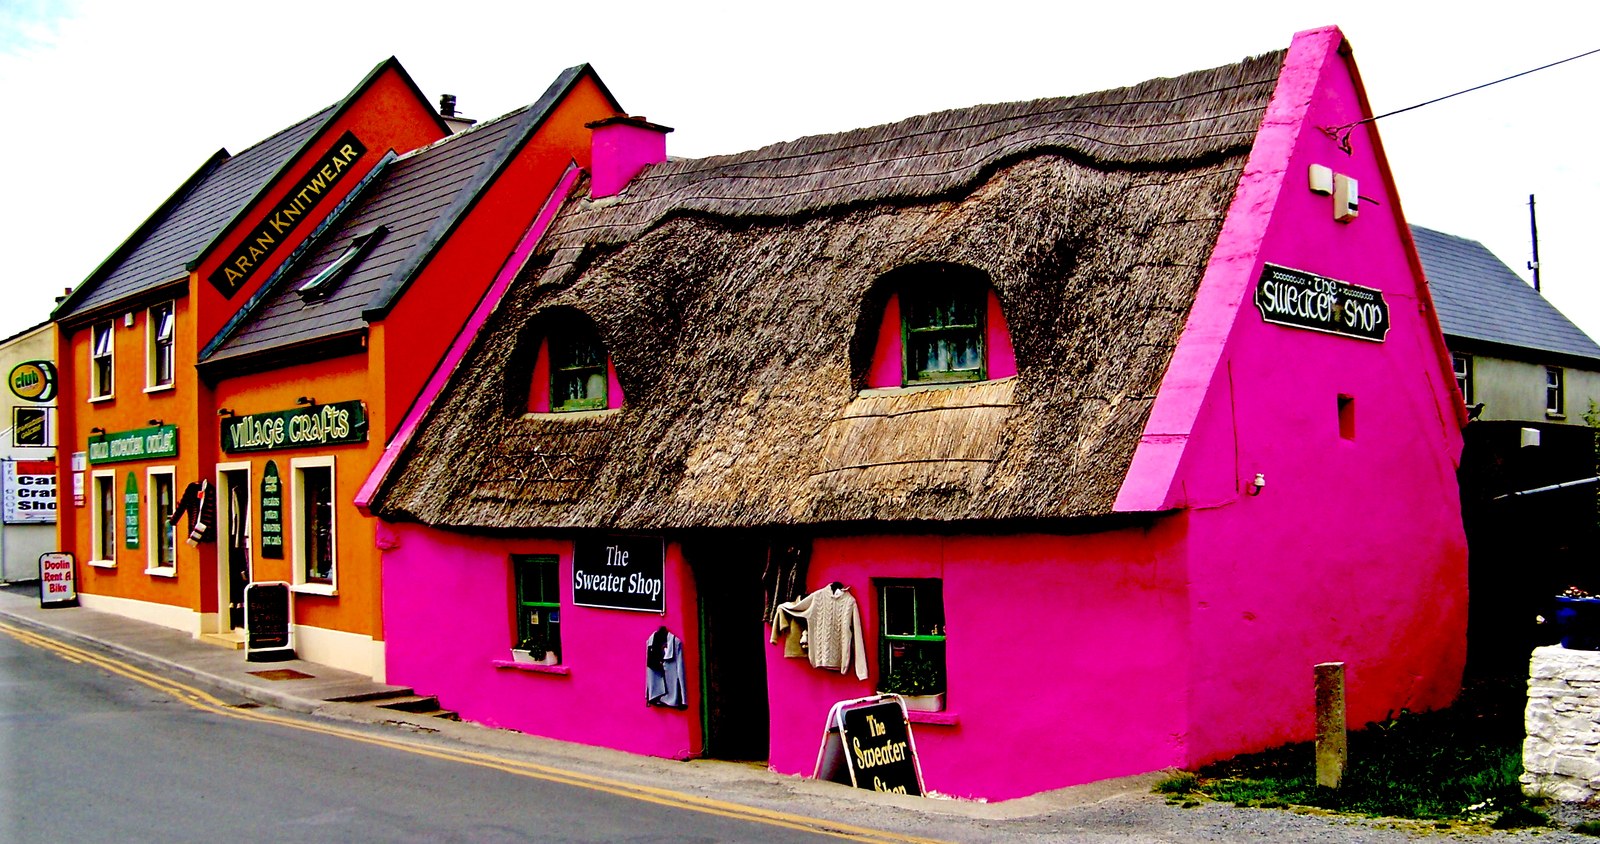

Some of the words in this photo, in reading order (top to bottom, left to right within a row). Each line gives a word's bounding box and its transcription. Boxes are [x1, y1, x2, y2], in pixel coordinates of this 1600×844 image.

[223, 231, 275, 287] ARAN
[269, 143, 358, 235] KNITWEAR
[15, 370, 39, 388] club
[18, 476, 57, 485] Caf
[18, 488, 57, 498] Craf
[18, 500, 57, 510] Sho
[606, 545, 629, 567] The
[44, 560, 70, 570] Doolin
[44, 572, 63, 582] Rent
[65, 571, 72, 581] A
[49, 583, 68, 593] Bike
[575, 570, 626, 593] Sweater
[628, 572, 661, 601] Shop
[866, 714, 886, 738] The
[853, 736, 907, 770] Sweater
